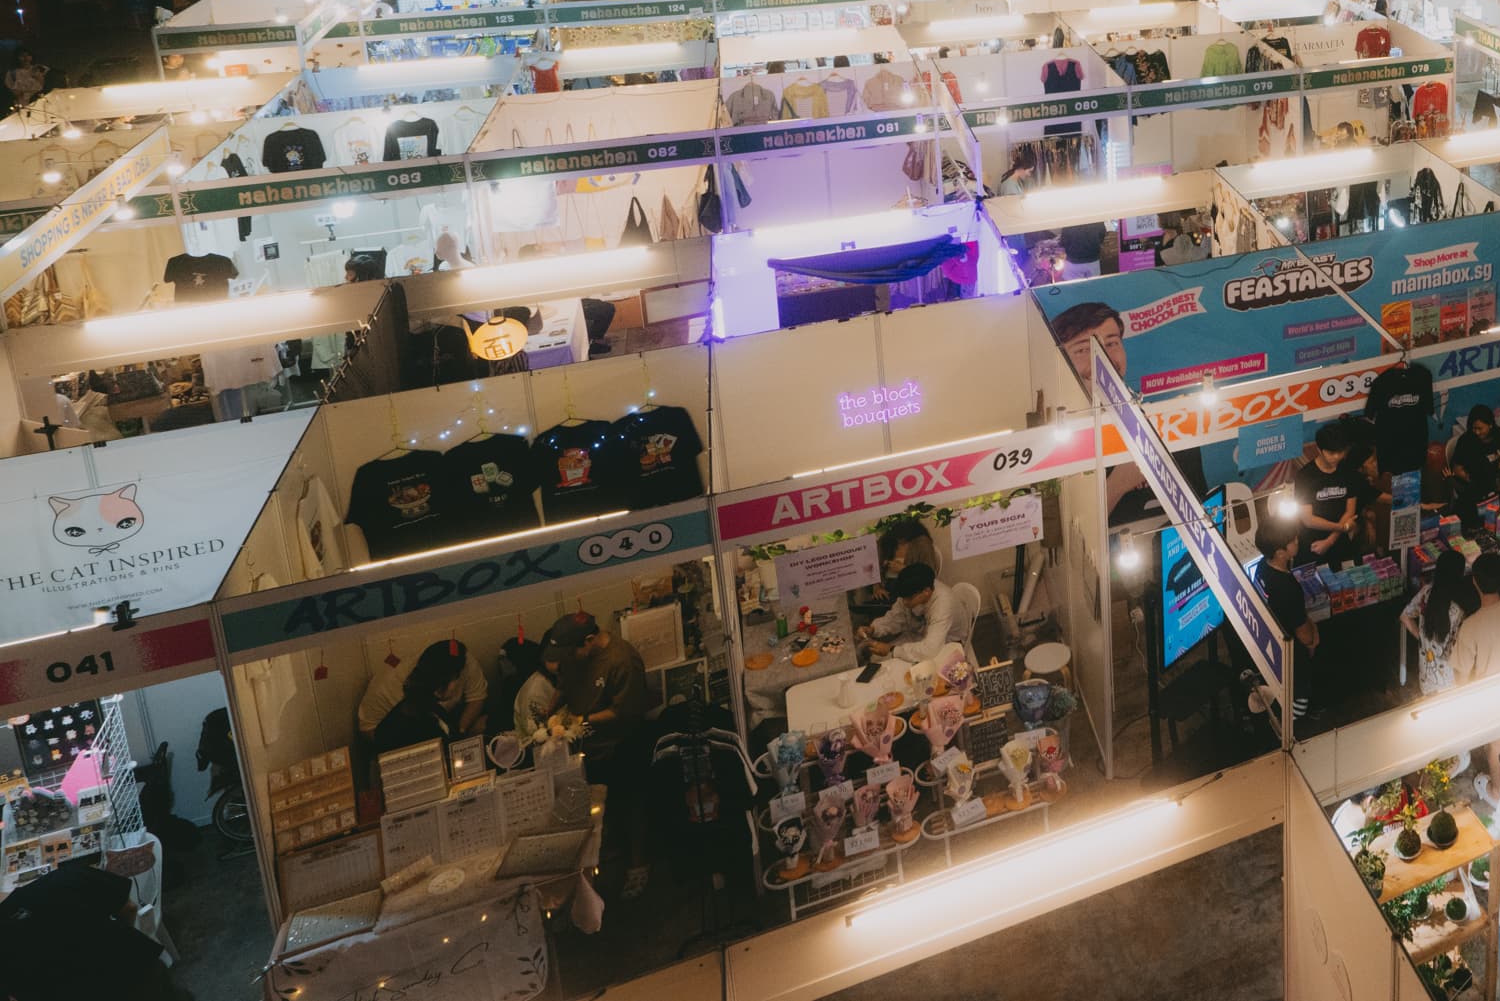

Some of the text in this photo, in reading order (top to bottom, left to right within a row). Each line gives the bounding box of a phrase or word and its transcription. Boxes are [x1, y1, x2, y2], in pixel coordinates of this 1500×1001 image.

[495, 14, 515, 25] 125
[1478, 30, 1493, 46] THAI
[1075, 99, 1098, 111] 080
[876, 122, 899, 136] 081
[648, 145, 678, 159] 082
[387, 171, 422, 187] 083
[20, 218, 70, 269] SHOPPING
[71, 210, 81, 225] IS
[82, 187, 109, 217] NEVER
[1413, 250, 1468, 270] Shop More at
[1226, 257, 1373, 304] FEASTABLES
[1391, 262, 1493, 296] mamabox.sg
[1128, 293, 1196, 321] WORLD'S BEST
[1131, 302, 1198, 332] CHOCOLATE
[1218, 363, 1239, 375] Yours
[1240, 358, 1262, 370] Today
[840, 382, 921, 412] the block
[842, 399, 921, 428] bouquets
[1255, 441, 1286, 456] PAYMENT
[1256, 435, 1277, 448] ORDER
[993, 447, 1034, 472] 039
[1144, 445, 1180, 493] ARCADE
[771, 461, 953, 526] ARTBOX
[969, 513, 1026, 531] YOUR SIGN
[1179, 488, 1206, 549] ALLEY
[50, 560, 100, 584] CAT
[108, 537, 226, 571] INSPIRED
[42, 571, 135, 594] ILLUSTRATIONS
[153, 562, 181, 574] PINS
[283, 529, 663, 635] ARTBOX 040
[1235, 589, 1259, 638] 40m
[46, 651, 114, 683] 041
